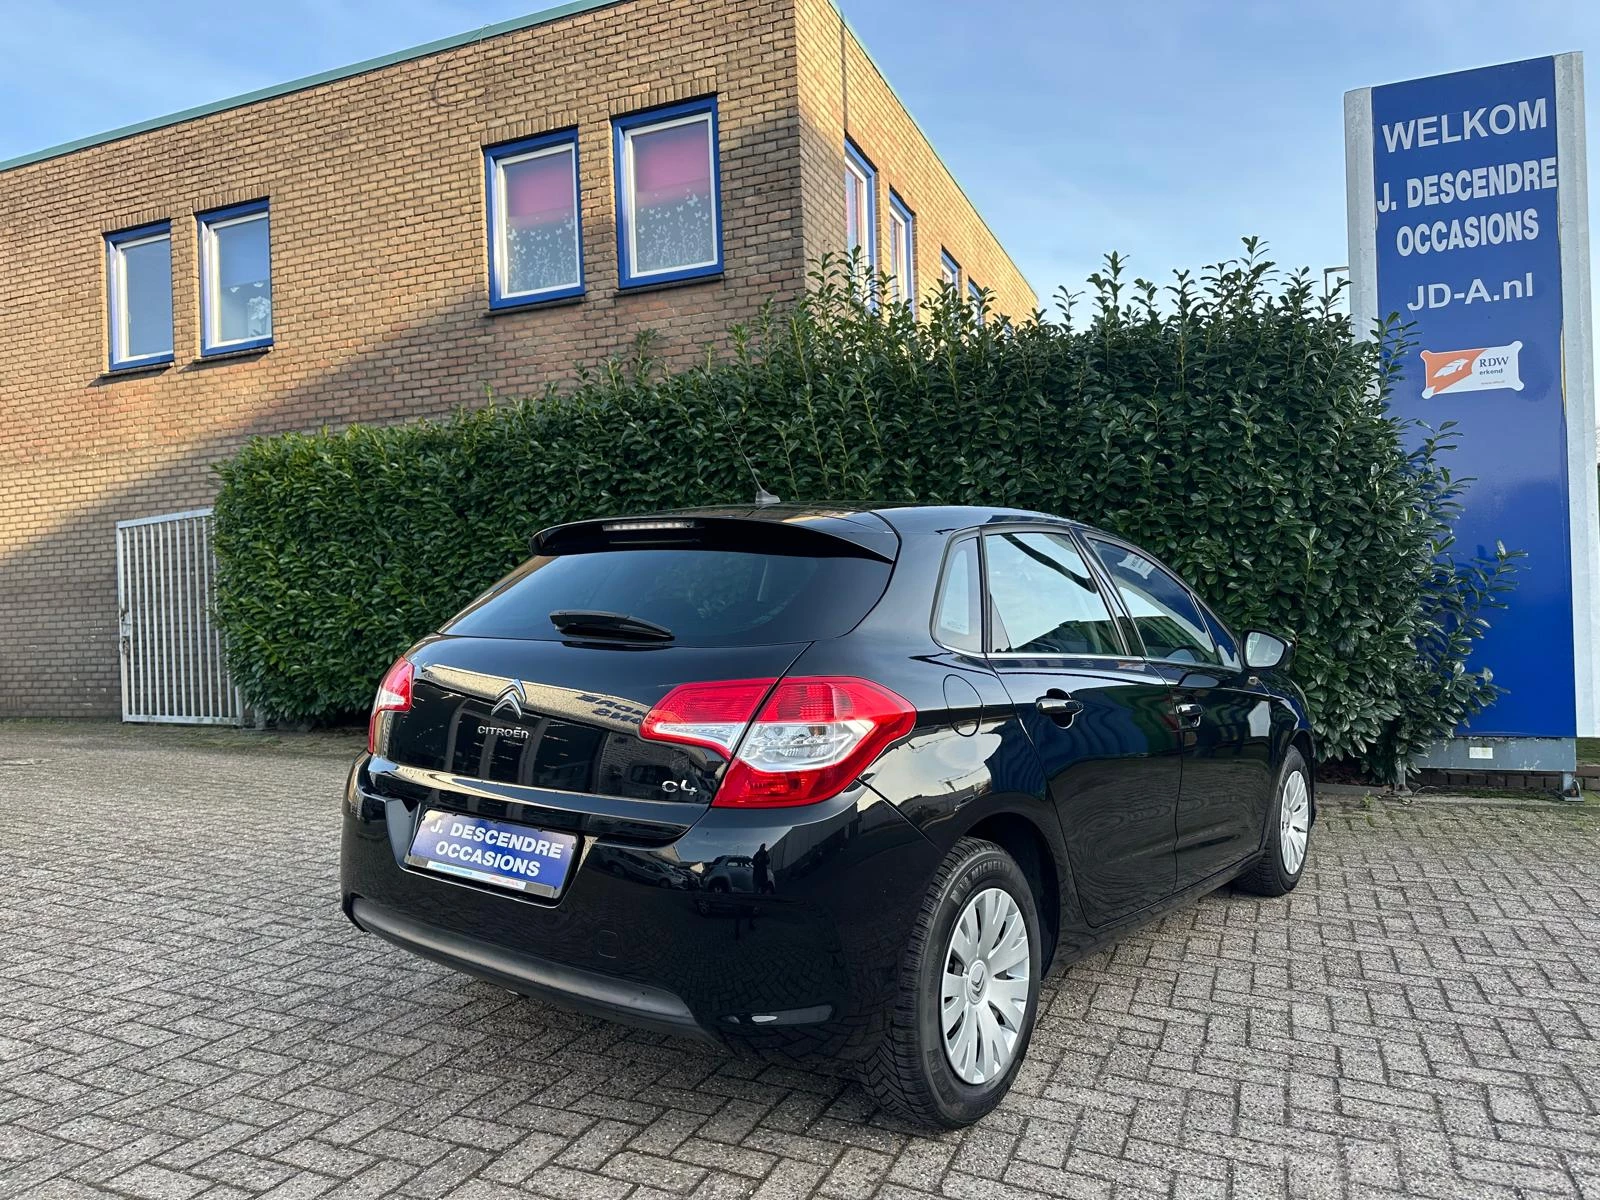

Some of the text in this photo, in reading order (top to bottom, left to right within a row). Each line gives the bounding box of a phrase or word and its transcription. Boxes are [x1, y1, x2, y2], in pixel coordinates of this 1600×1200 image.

[1382, 97, 1547, 153] WELKOM
[1377, 157, 1557, 213] J. DESCENDRE
[1396, 208, 1539, 257] OCCASIONS
[1407, 272, 1534, 312] JD-A.nl
[1480, 356, 1508, 367] RDW
[477, 725, 529, 739] CITROËN
[662, 779, 698, 796] C4
[430, 820, 564, 859] J. DESCENDRE
[435, 841, 541, 877] OCCASIONS
